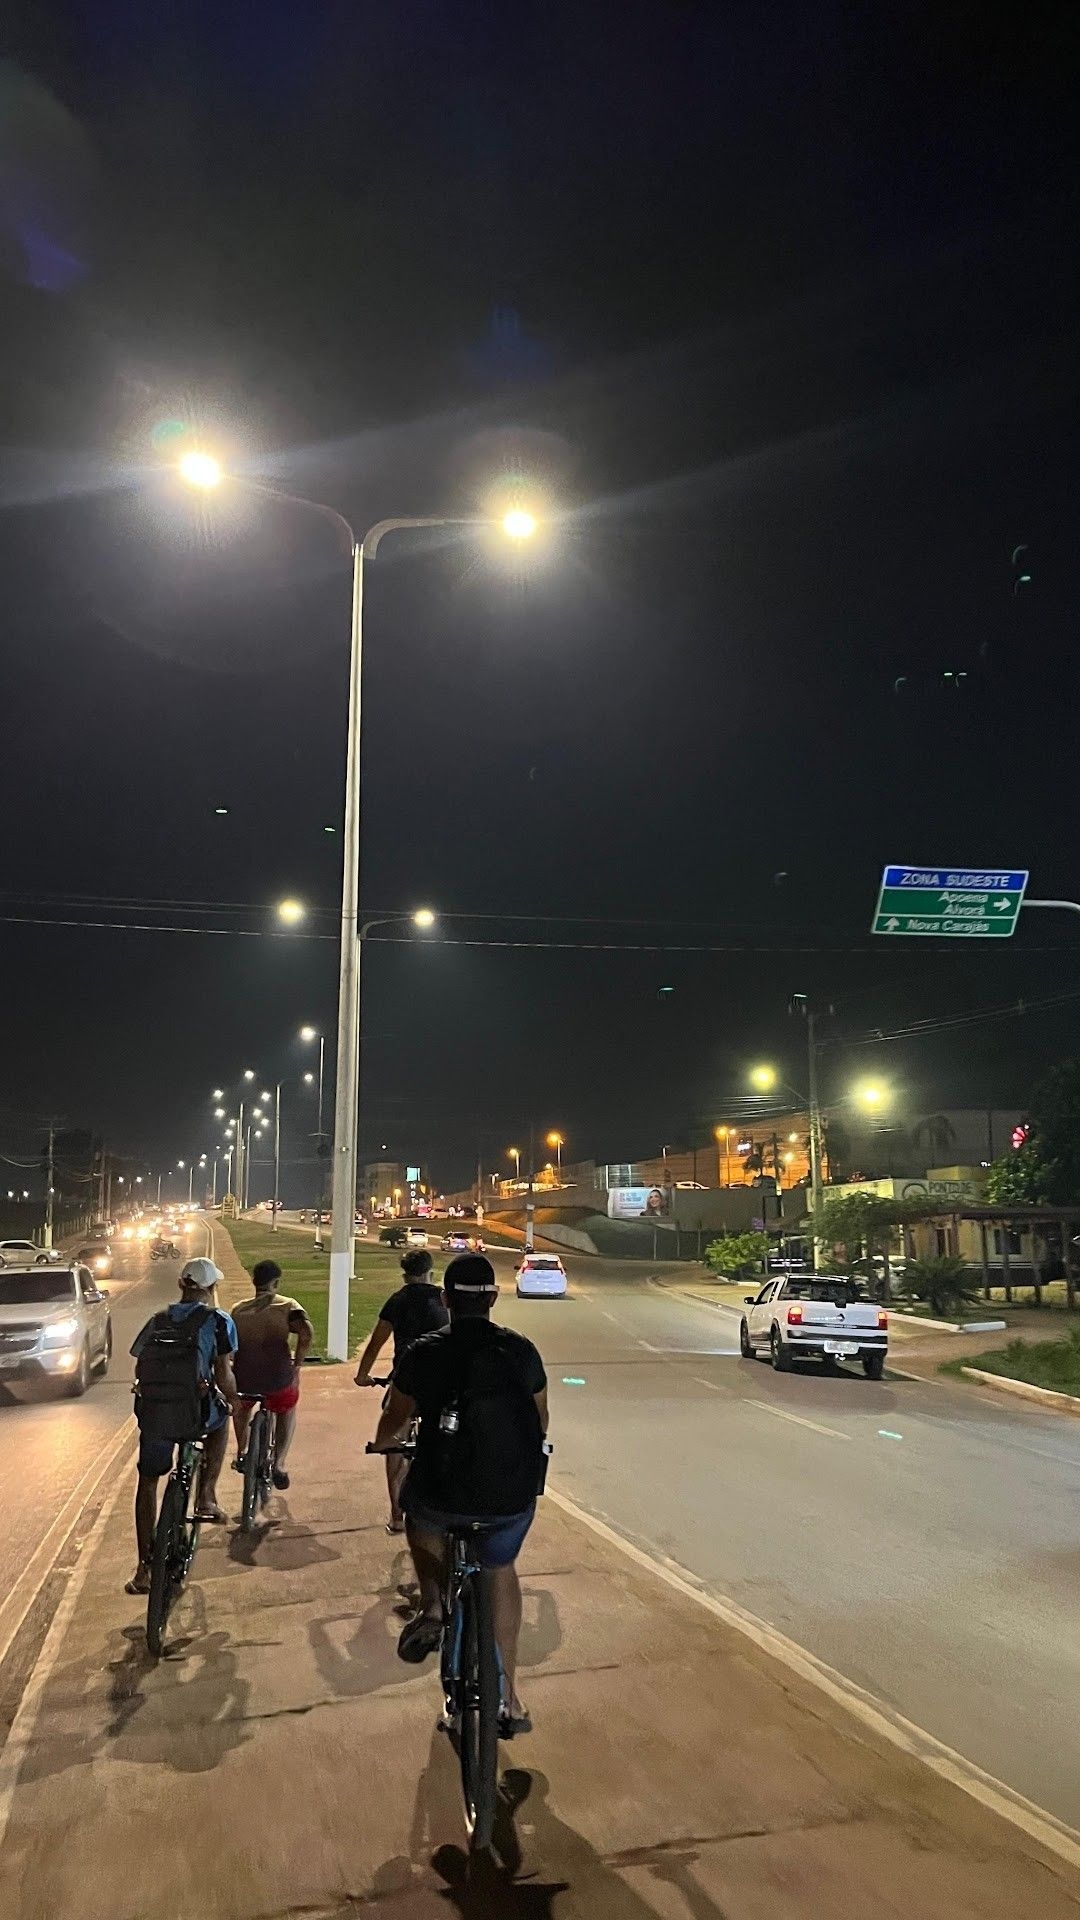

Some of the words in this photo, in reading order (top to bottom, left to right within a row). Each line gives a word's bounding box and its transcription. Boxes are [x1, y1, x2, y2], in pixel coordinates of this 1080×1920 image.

[900, 873, 940, 885] ZONA
[945, 875, 1010, 887] SUDESTE
[906, 919, 940, 930] Nova
[941, 919, 990, 933] Carajás
